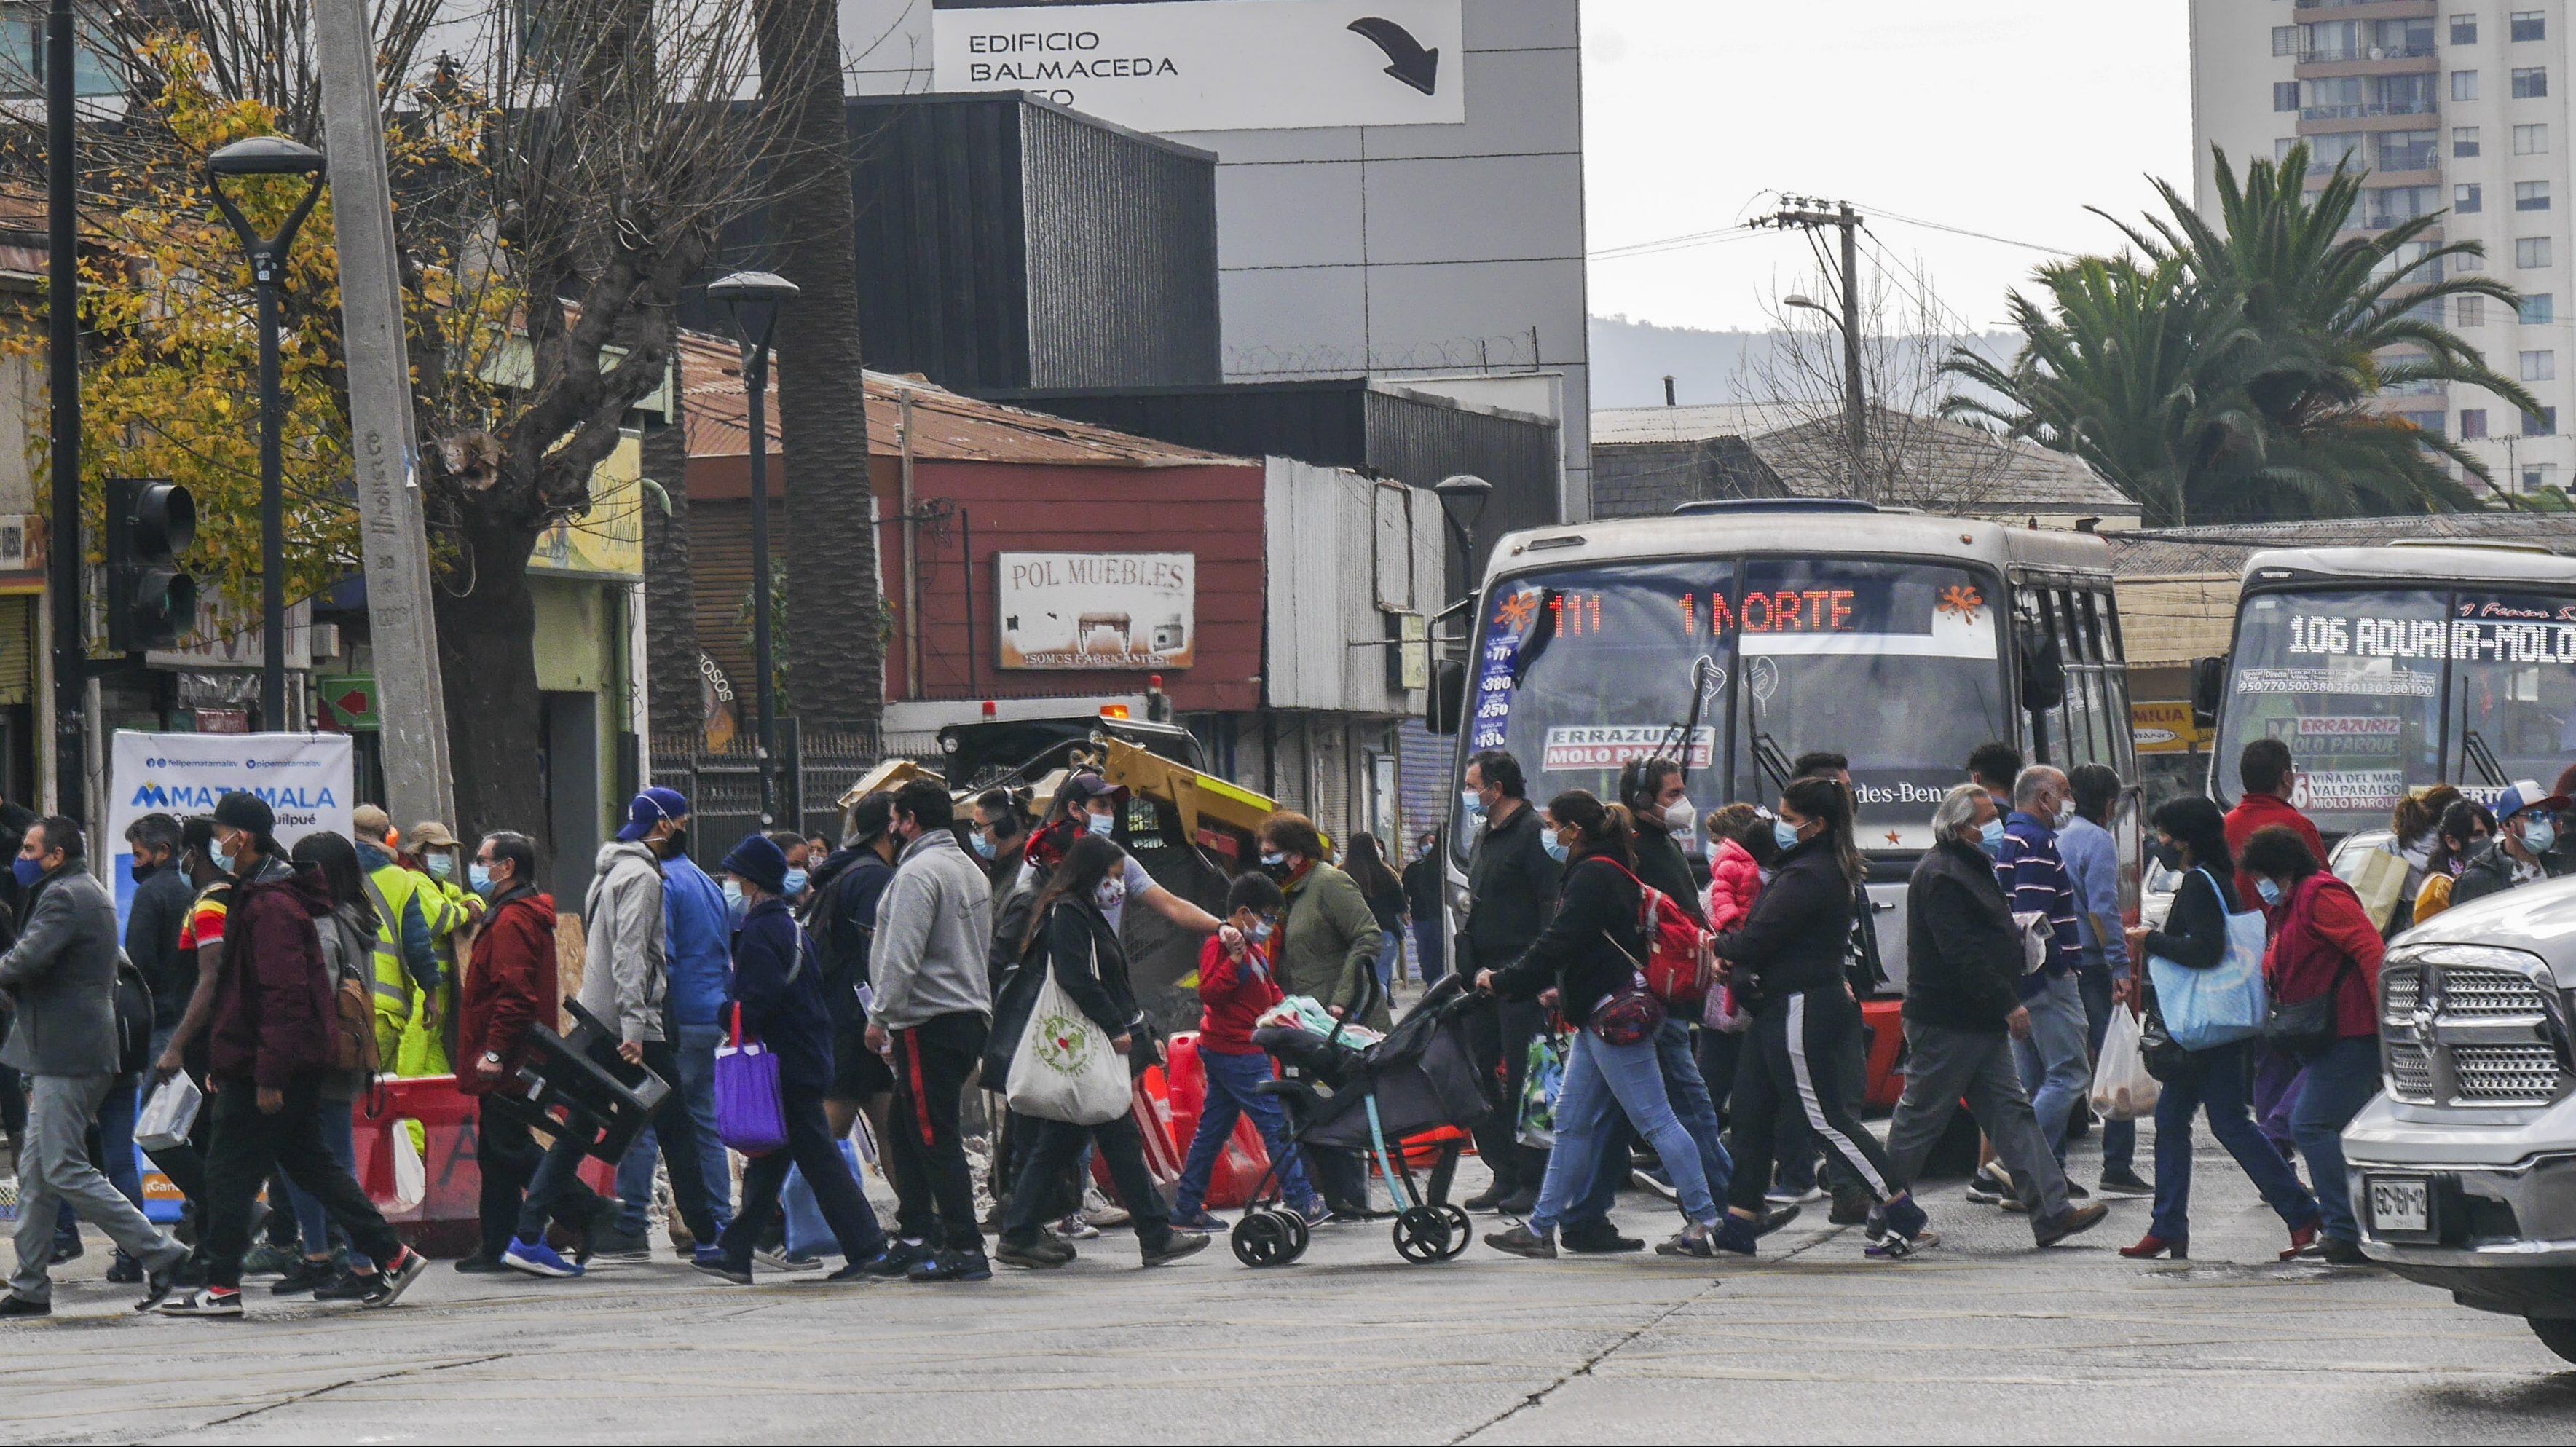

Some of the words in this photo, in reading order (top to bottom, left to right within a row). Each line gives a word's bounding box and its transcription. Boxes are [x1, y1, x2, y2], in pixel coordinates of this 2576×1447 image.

[969, 31, 1100, 53] EDIFICIO
[970, 57, 1179, 82] BALMACEDA
[1012, 561, 1060, 590] POL
[1068, 559, 1184, 589] MUEBLES
[1548, 594, 1600, 638] 111
[1679, 592, 1693, 635] 1
[1713, 591, 1855, 636] NORTE
[2289, 614, 2349, 654] 106
[2266, 671, 2287, 679] Directo
[1481, 676, 1512, 692] $380
[2240, 681, 2261, 692] 950
[2264, 680, 2285, 691] 770
[2288, 681, 2309, 691] 500
[2312, 681, 2334, 692] 380
[2336, 682, 2358, 693] 250
[2360, 683, 2383, 693] 130
[2384, 683, 2408, 694] 380
[2410, 685, 2433, 695] 190
[1478, 703, 1509, 719] $250
[2301, 718, 2397, 733] ERRAZURIZ
[2331, 736, 2397, 753] PARQUE
[1548, 749, 1611, 763] MOLO
[171, 786, 336, 808] MATMALA
[2288, 777, 2308, 809] 6
[2312, 773, 2343, 784] VIÑA
[2346, 773, 2369, 784] DEL
[2372, 773, 2401, 784] MAR
[2312, 784, 2401, 796] VALPARAISO
[2312, 797, 2349, 809] MOLO
